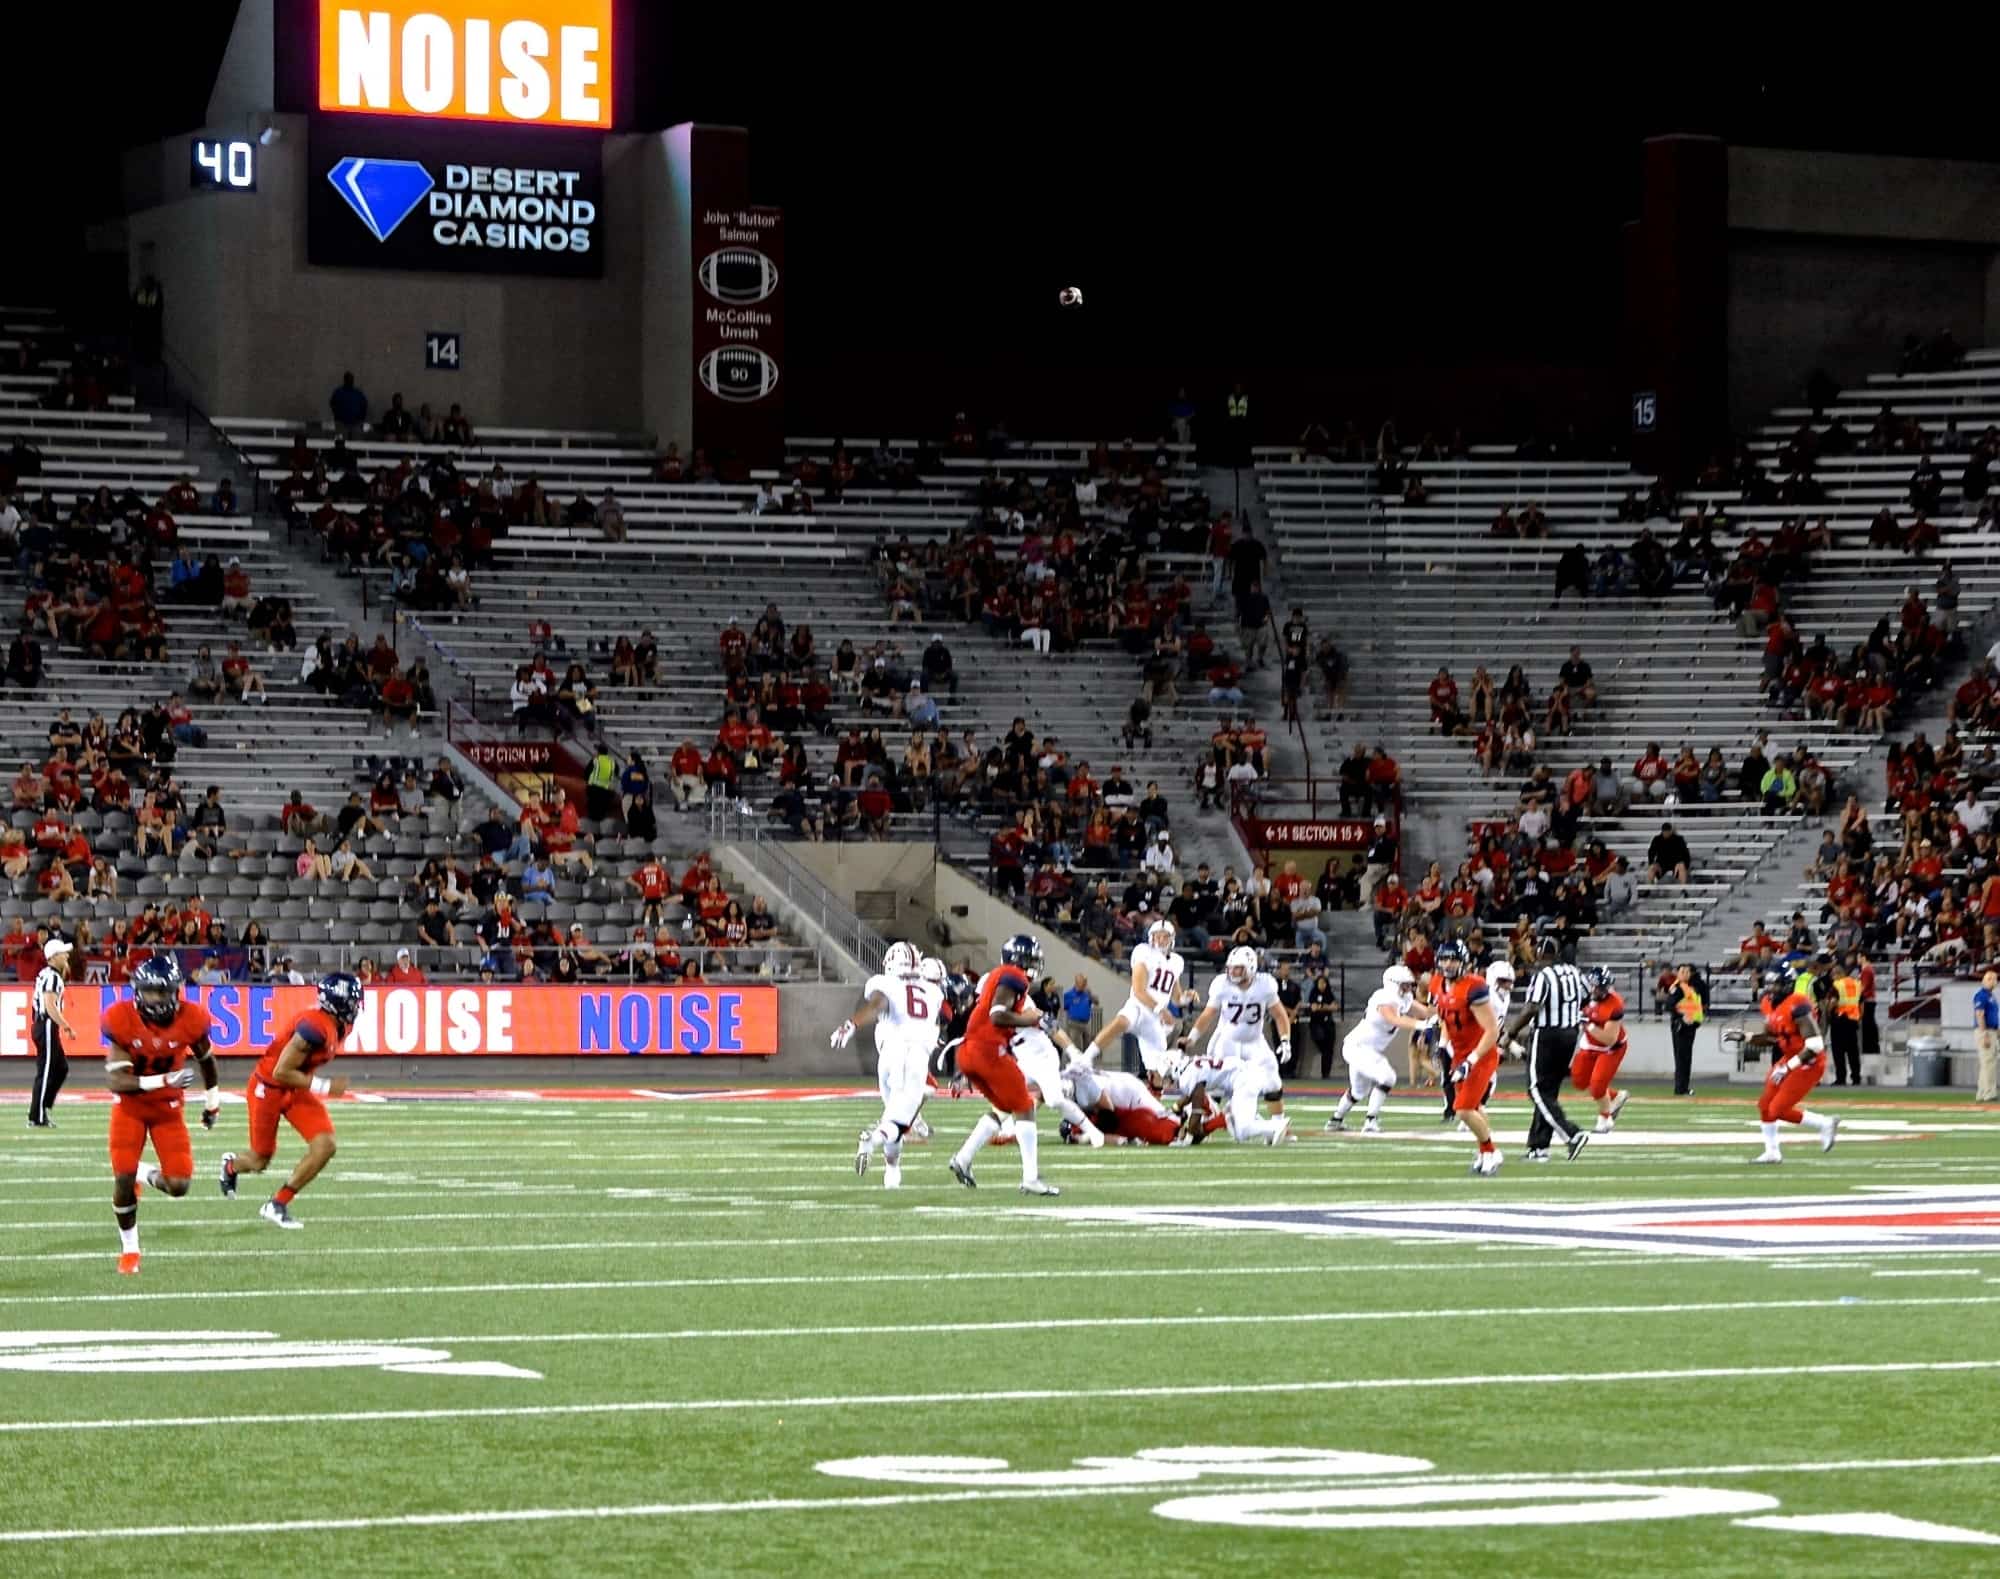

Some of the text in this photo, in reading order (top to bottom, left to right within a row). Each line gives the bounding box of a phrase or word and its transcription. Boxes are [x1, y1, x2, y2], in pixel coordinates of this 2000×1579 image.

[338, 9, 600, 122] NOISE
[198, 141, 252, 187] 40
[446, 164, 580, 197] DESERT
[430, 191, 596, 225] DIAMOND
[703, 210, 730, 225] John
[433, 219, 591, 253] CASINOS
[719, 226, 759, 243] Salmon
[706, 307, 772, 326] McCollins
[720, 324, 759, 340] Umeh
[427, 336, 459, 365] 14
[730, 367, 749, 382] 90
[1633, 398, 1655, 426] 15
[1277, 824, 1288, 841] 14
[1292, 824, 1337, 842] SECTION
[1150, 967, 1175, 994] 10
[905, 985, 928, 1019] 6
[1227, 1002, 1262, 1025] 73
[344, 989, 513, 1053] NOISE
[580, 992, 742, 1054] NOISE
